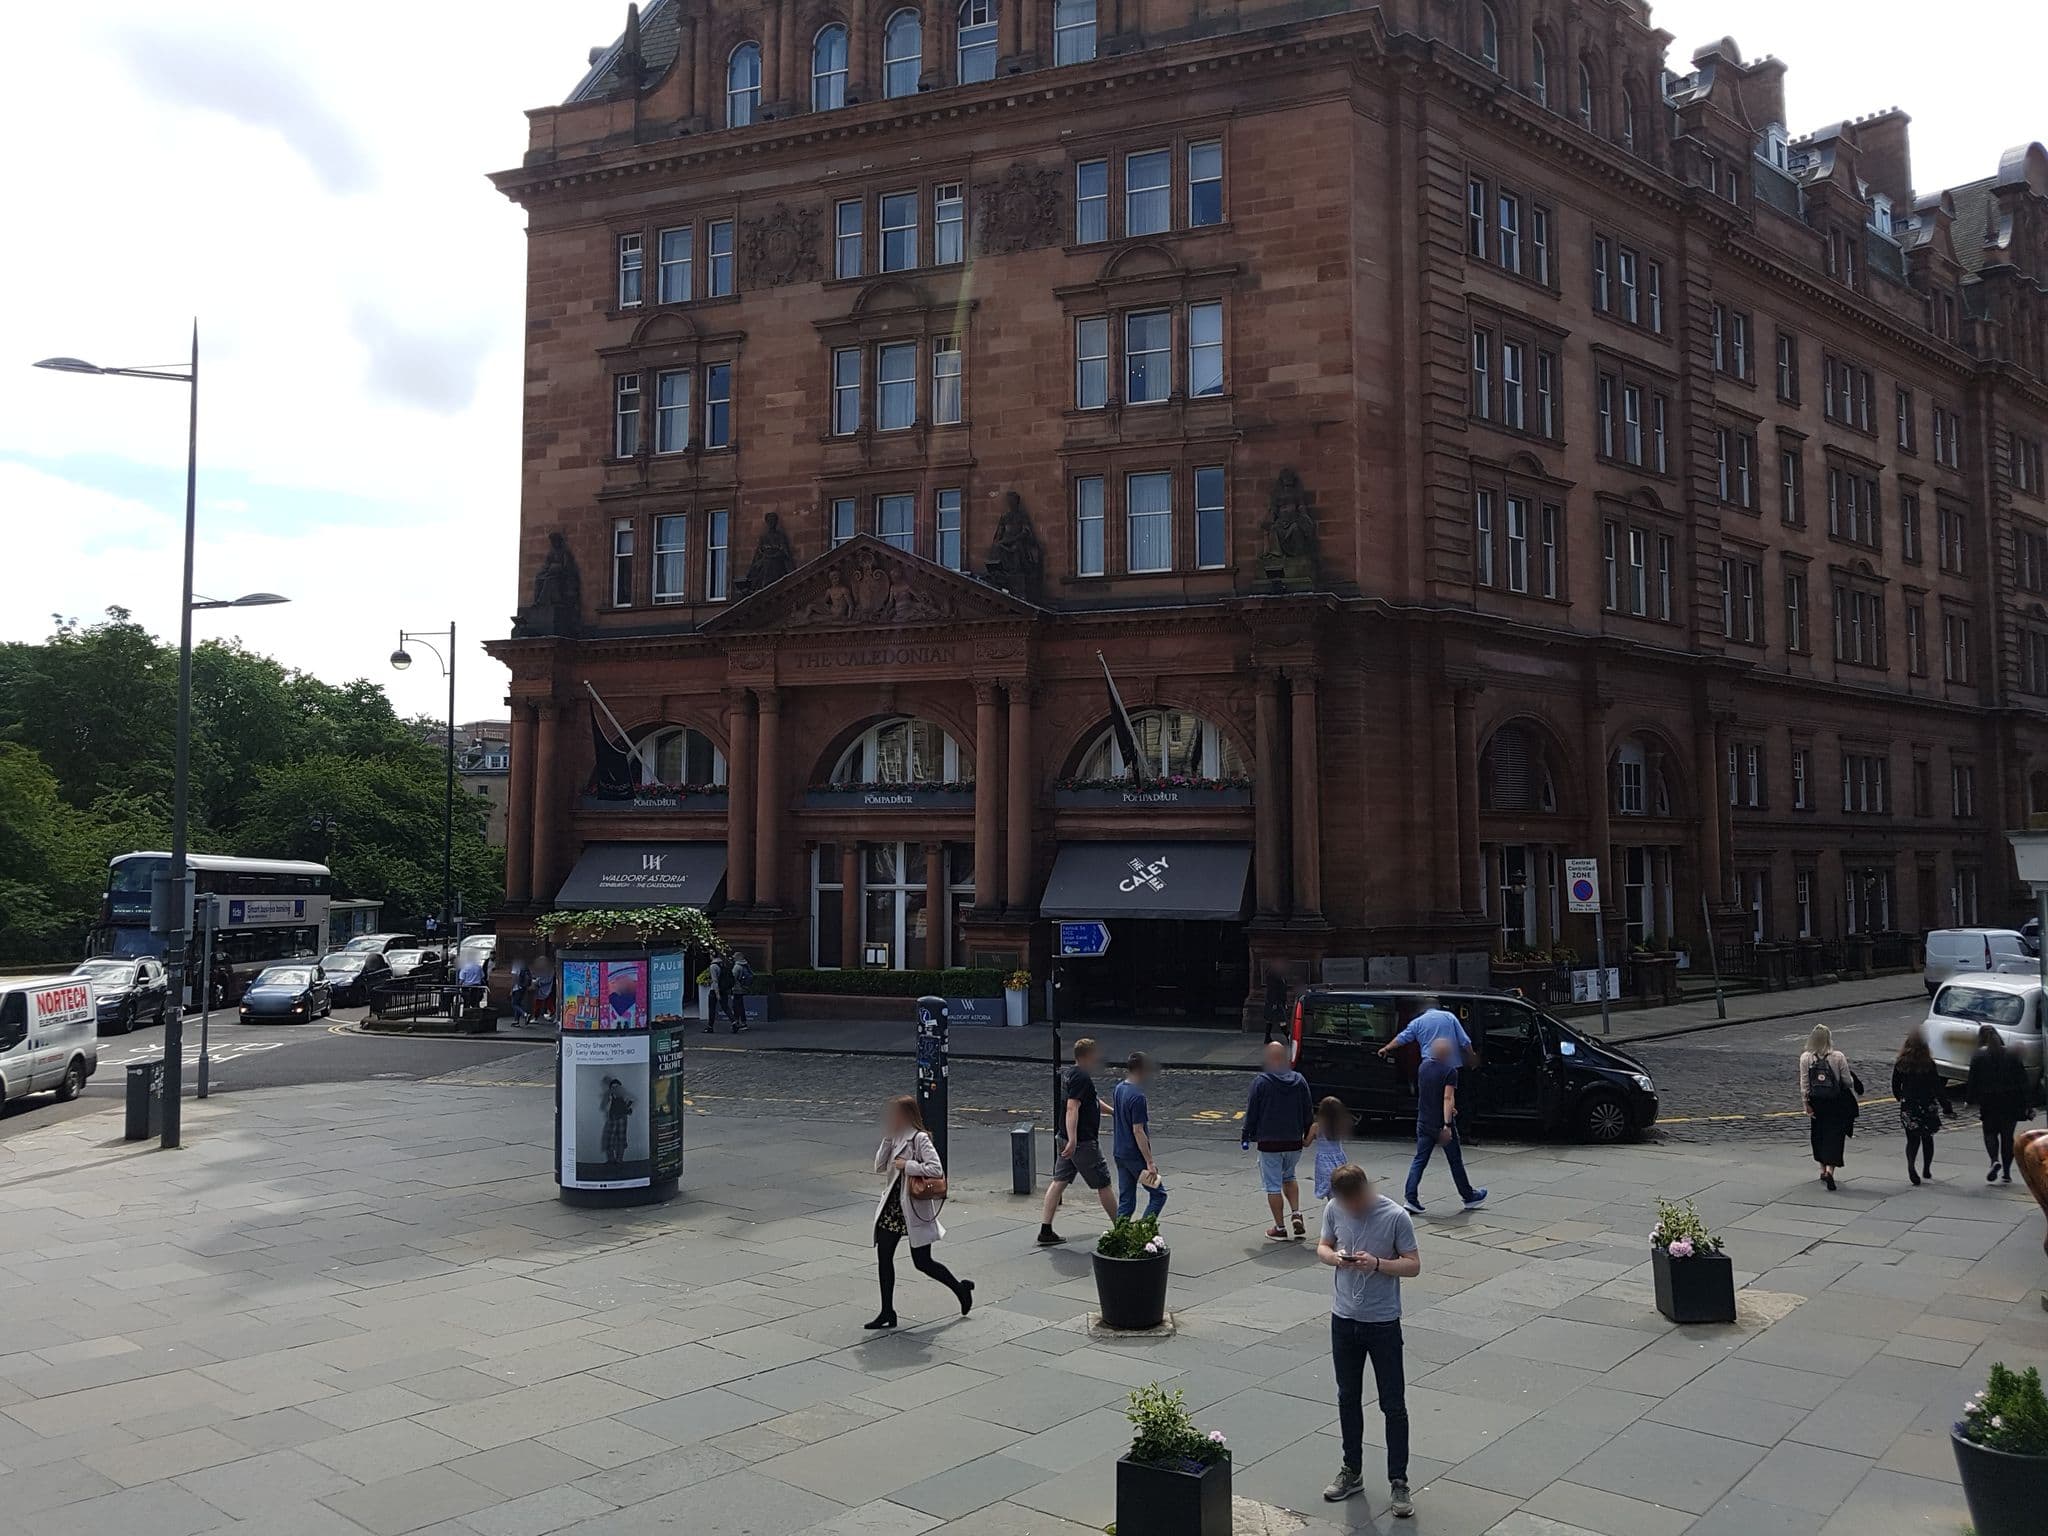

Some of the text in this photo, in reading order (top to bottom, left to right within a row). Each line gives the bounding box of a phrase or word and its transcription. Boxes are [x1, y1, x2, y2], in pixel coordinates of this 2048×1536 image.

[836, 646, 957, 667] CALEDONIAN
[1130, 858, 1144, 871] THE
[602, 874, 686, 882] WALDORF ASTORIA
[1119, 856, 1169, 892] CALEY
[1149, 877, 1164, 892] BAR
[36, 986, 88, 1016] NORTECH
[653, 991, 672, 1000] CASTLE
